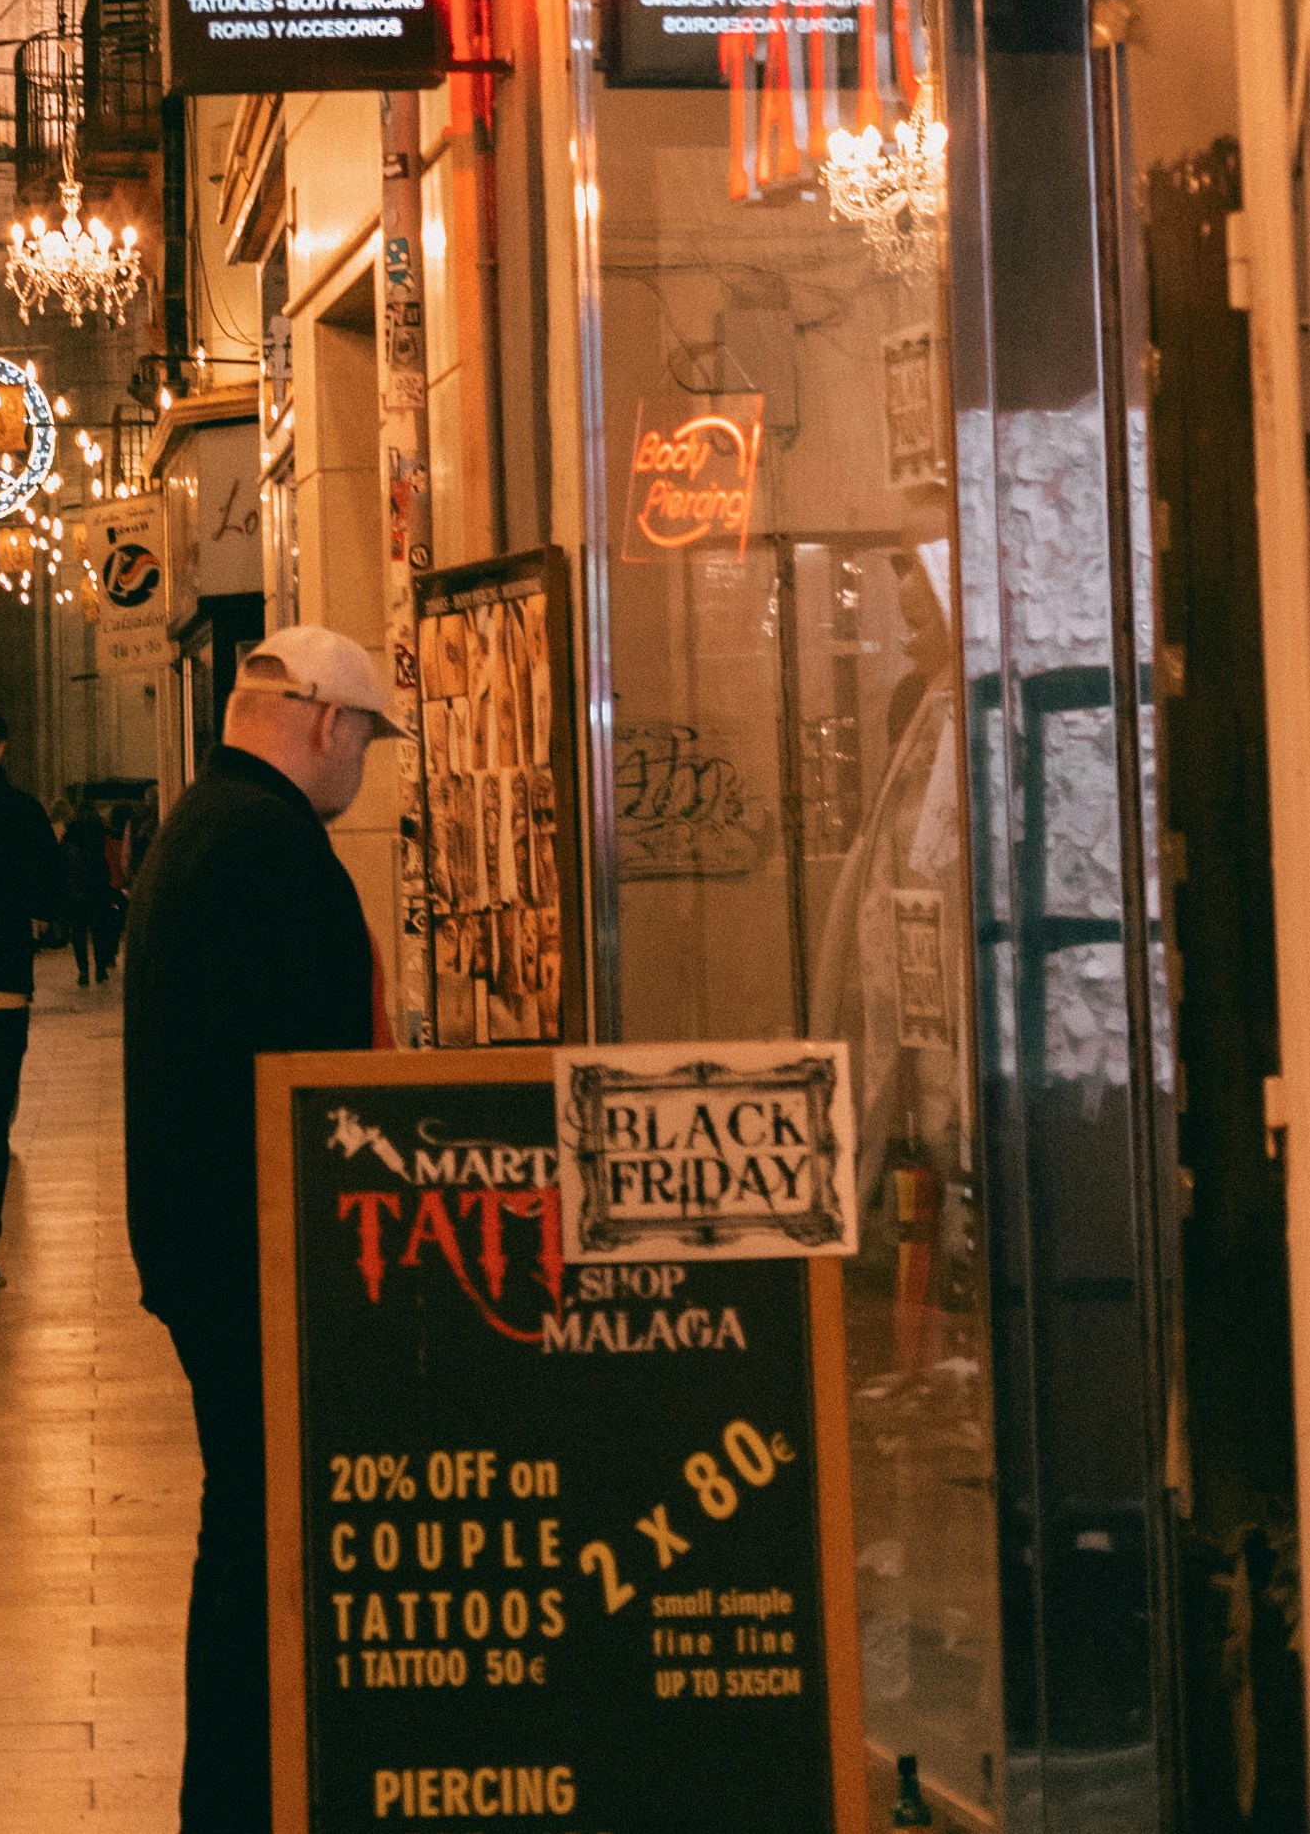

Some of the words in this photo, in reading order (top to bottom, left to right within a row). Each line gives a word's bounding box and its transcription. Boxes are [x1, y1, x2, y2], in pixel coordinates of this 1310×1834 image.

[208, 19, 270, 40] ROPAS
[270, 20, 286, 39] Y
[286, 17, 403, 38] ACCESORIOS
[635, 430, 712, 480] Body
[643, 478, 745, 529] Piercing
[607, 1101, 808, 1153] BLACK
[414, 1123, 560, 1191] MART
[609, 1154, 809, 1213] FRIDAY
[337, 1188, 565, 1340] TATT
[580, 1264, 687, 1301] SHOP
[329, 1452, 418, 1503] 20%
[427, 1449, 498, 1502] OFF
[509, 1459, 560, 1500] on
[331, 1517, 562, 1574] COUPLE
[578, 1539, 637, 1615] 2
[331, 1587, 567, 1643] TATTOOS
[650, 1587, 714, 1618] small
[717, 1586, 795, 1622] simple
[651, 1626, 714, 1658] fine
[735, 1625, 796, 1655] line
[336, 1652, 351, 1689] 1
[359, 1647, 469, 1689] TATTOO
[484, 1647, 548, 1686] 50€
[654, 1668, 688, 1700] UP
[689, 1667, 721, 1699] TO
[373, 1764, 577, 1819] PIERCING
